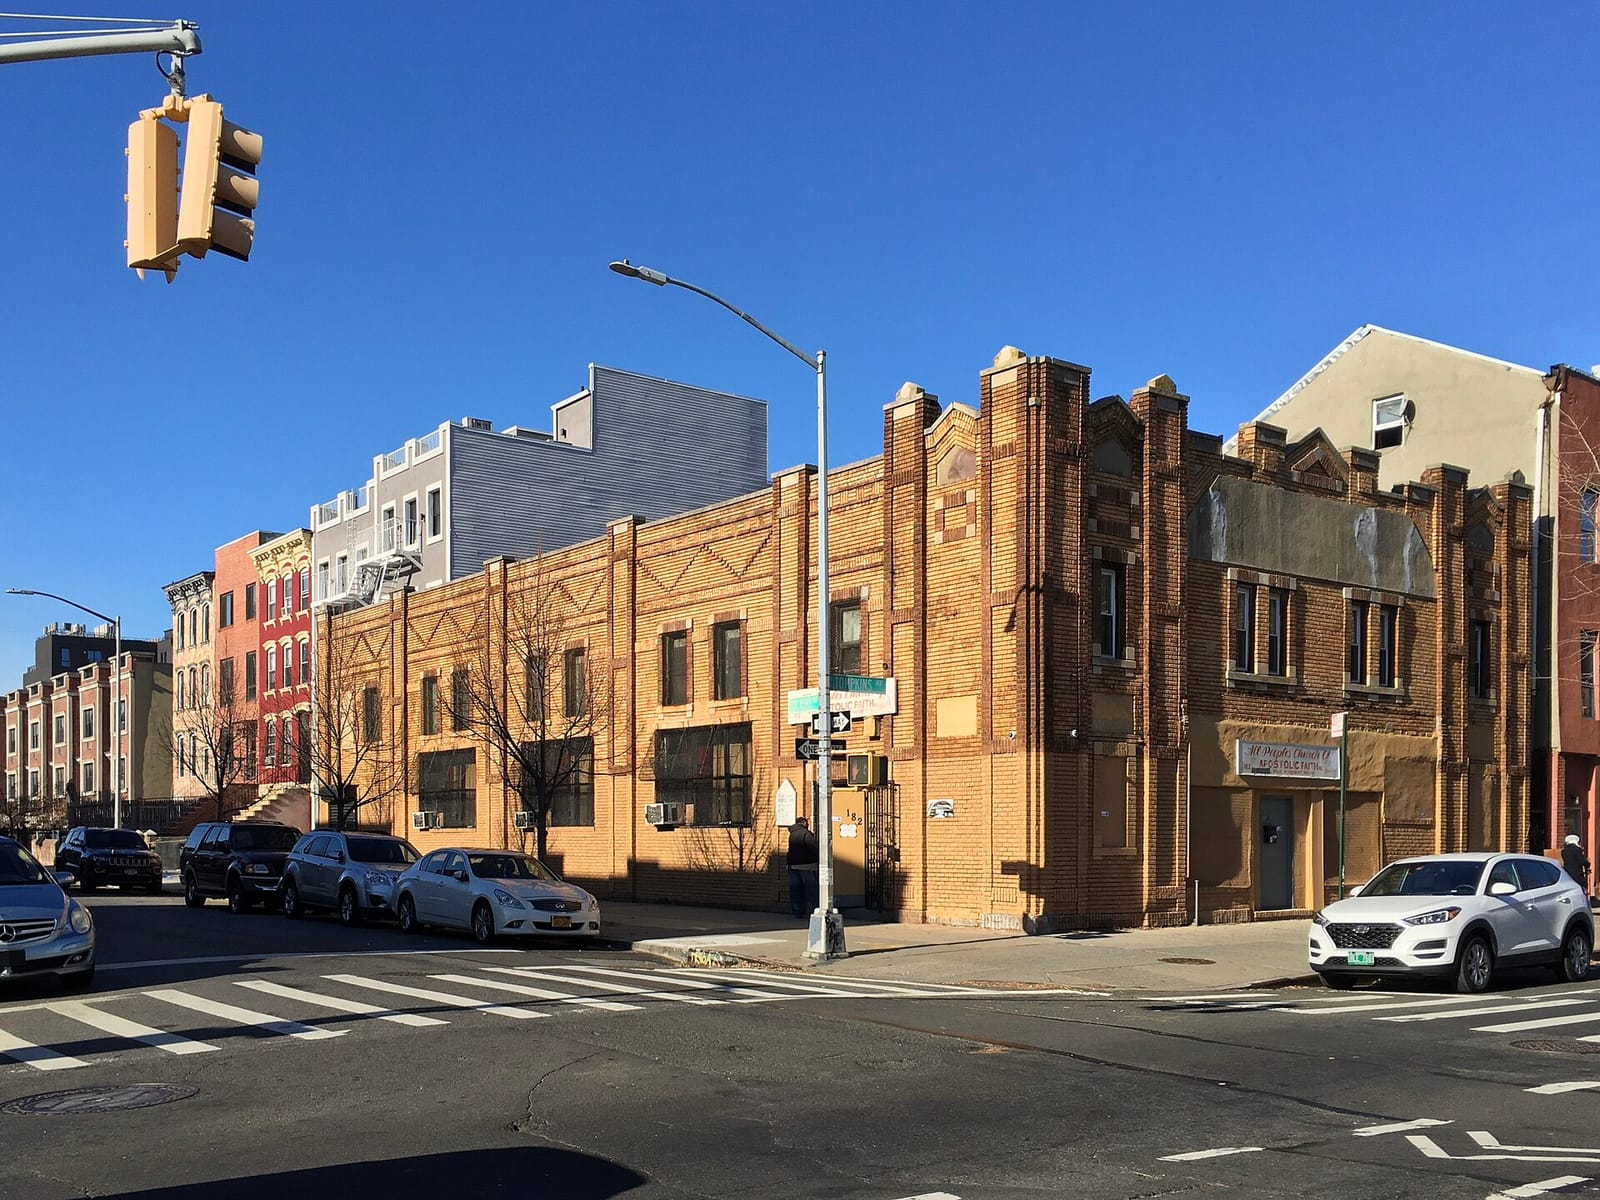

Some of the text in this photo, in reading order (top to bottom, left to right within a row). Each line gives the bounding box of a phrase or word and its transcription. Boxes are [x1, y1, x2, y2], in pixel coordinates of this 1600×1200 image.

[833, 677, 873, 691] TOMPKINS
[803, 744, 818, 754] ONE
[1260, 759, 1300, 770] APOSTOLIC
[1301, 761, 1319, 771] FAITH
[846, 808, 863, 826] 182
